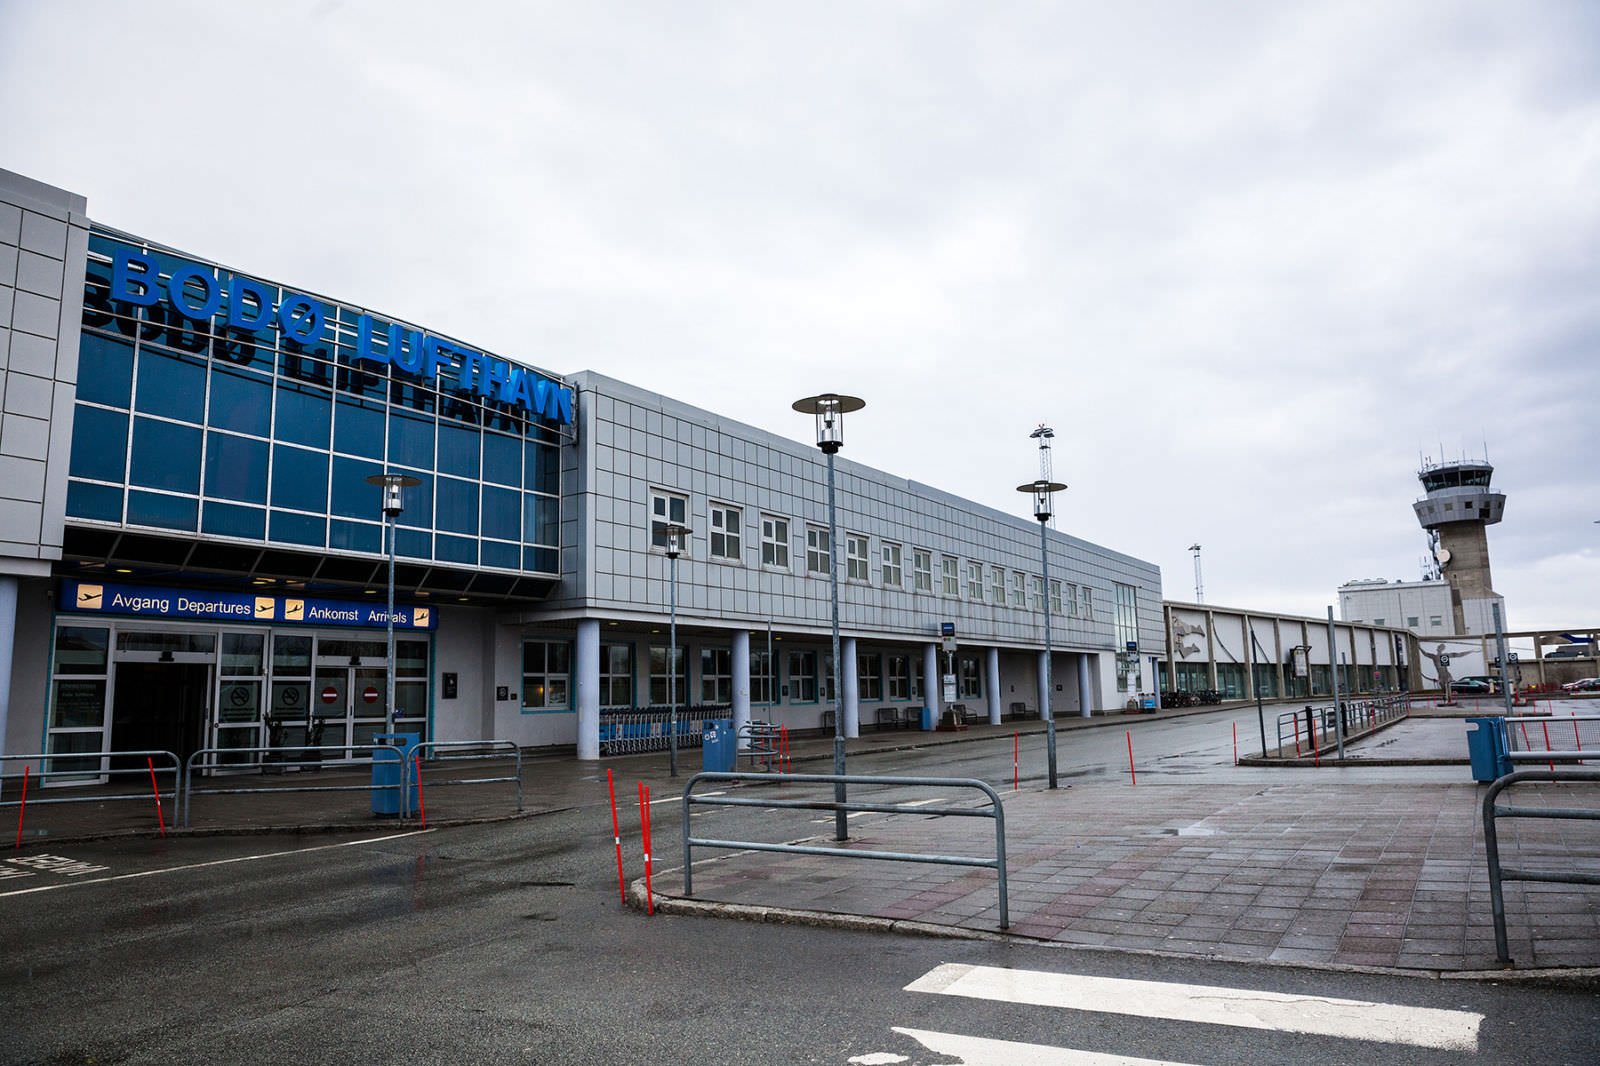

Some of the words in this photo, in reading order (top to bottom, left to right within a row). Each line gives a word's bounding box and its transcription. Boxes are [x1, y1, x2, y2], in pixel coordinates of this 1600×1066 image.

[111, 249, 326, 345] BODØ
[352, 314, 572, 425] LUFTHAVN
[111, 593, 169, 613] Avgang
[177, 598, 251, 615] Departures
[308, 606, 359, 621] Ankomst
